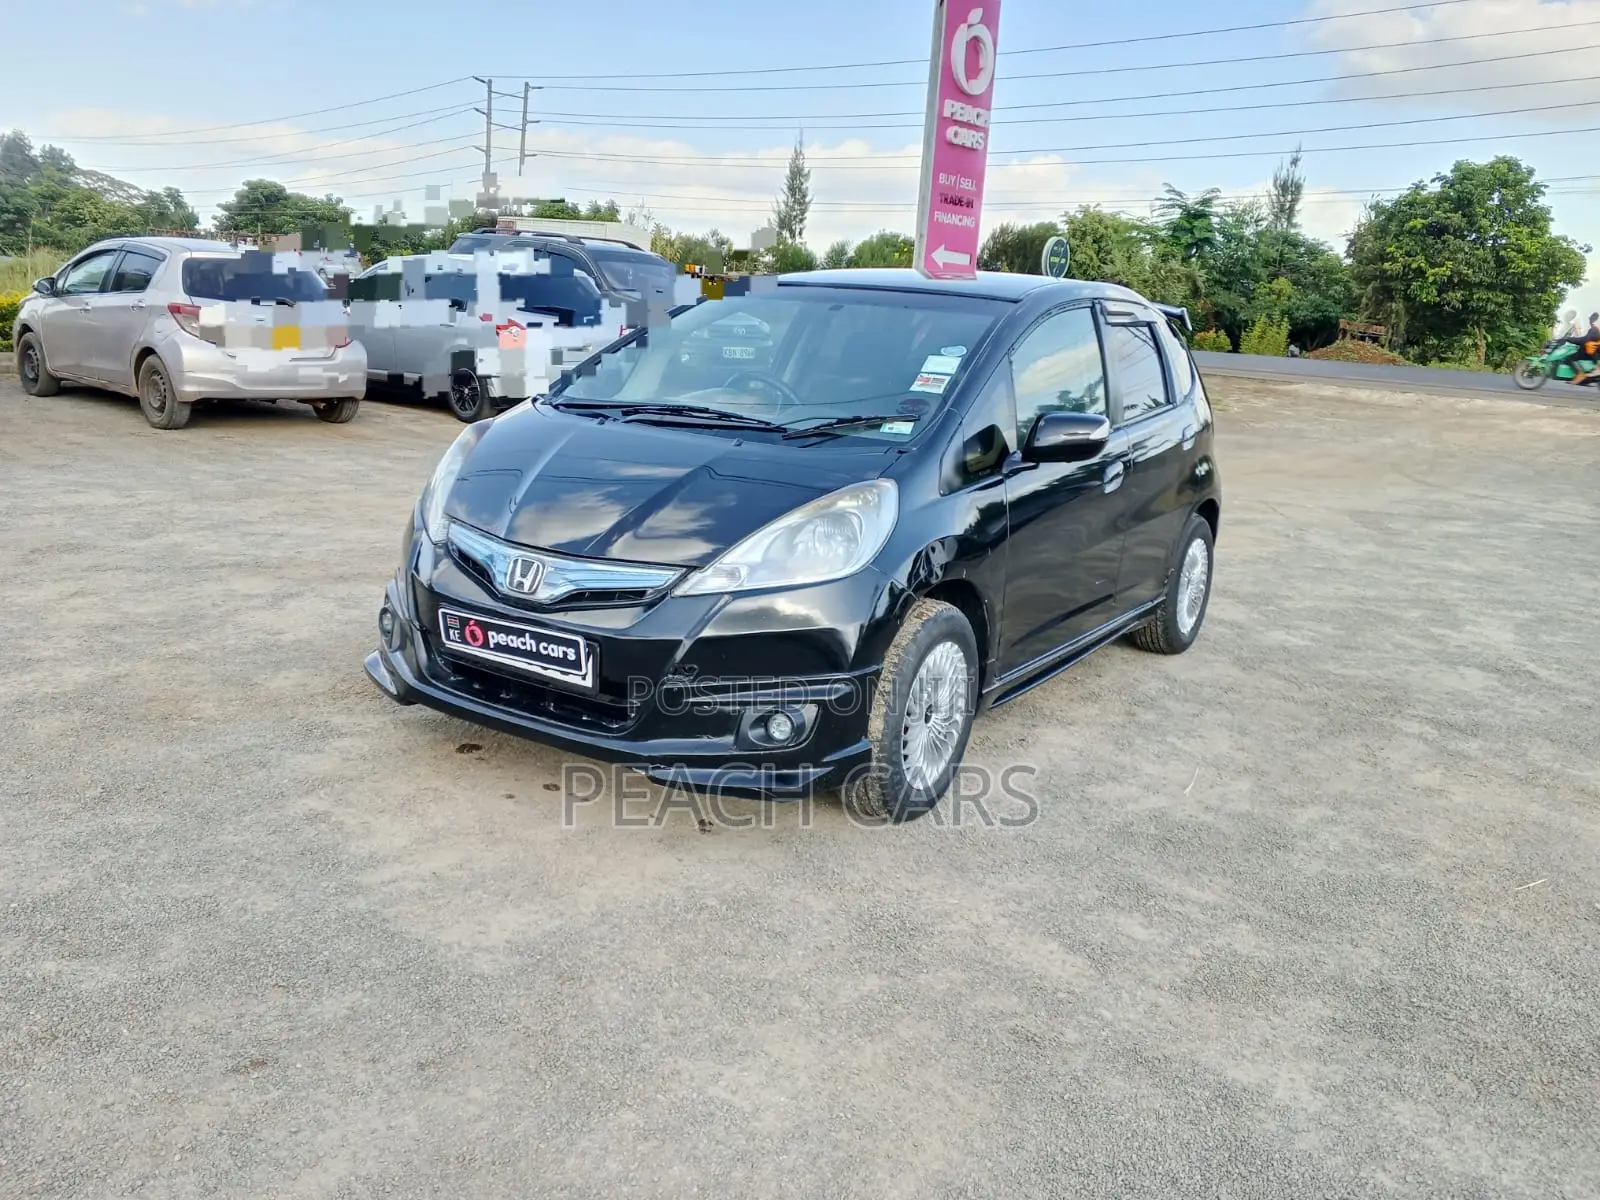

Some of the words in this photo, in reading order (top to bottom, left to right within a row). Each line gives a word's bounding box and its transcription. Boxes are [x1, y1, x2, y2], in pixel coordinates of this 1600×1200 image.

[946, 125, 985, 150] CARS
[934, 210, 976, 228] FINANCING
[449, 628, 462, 643] KE
[487, 631, 537, 653] peach
[539, 641, 576, 661] cars
